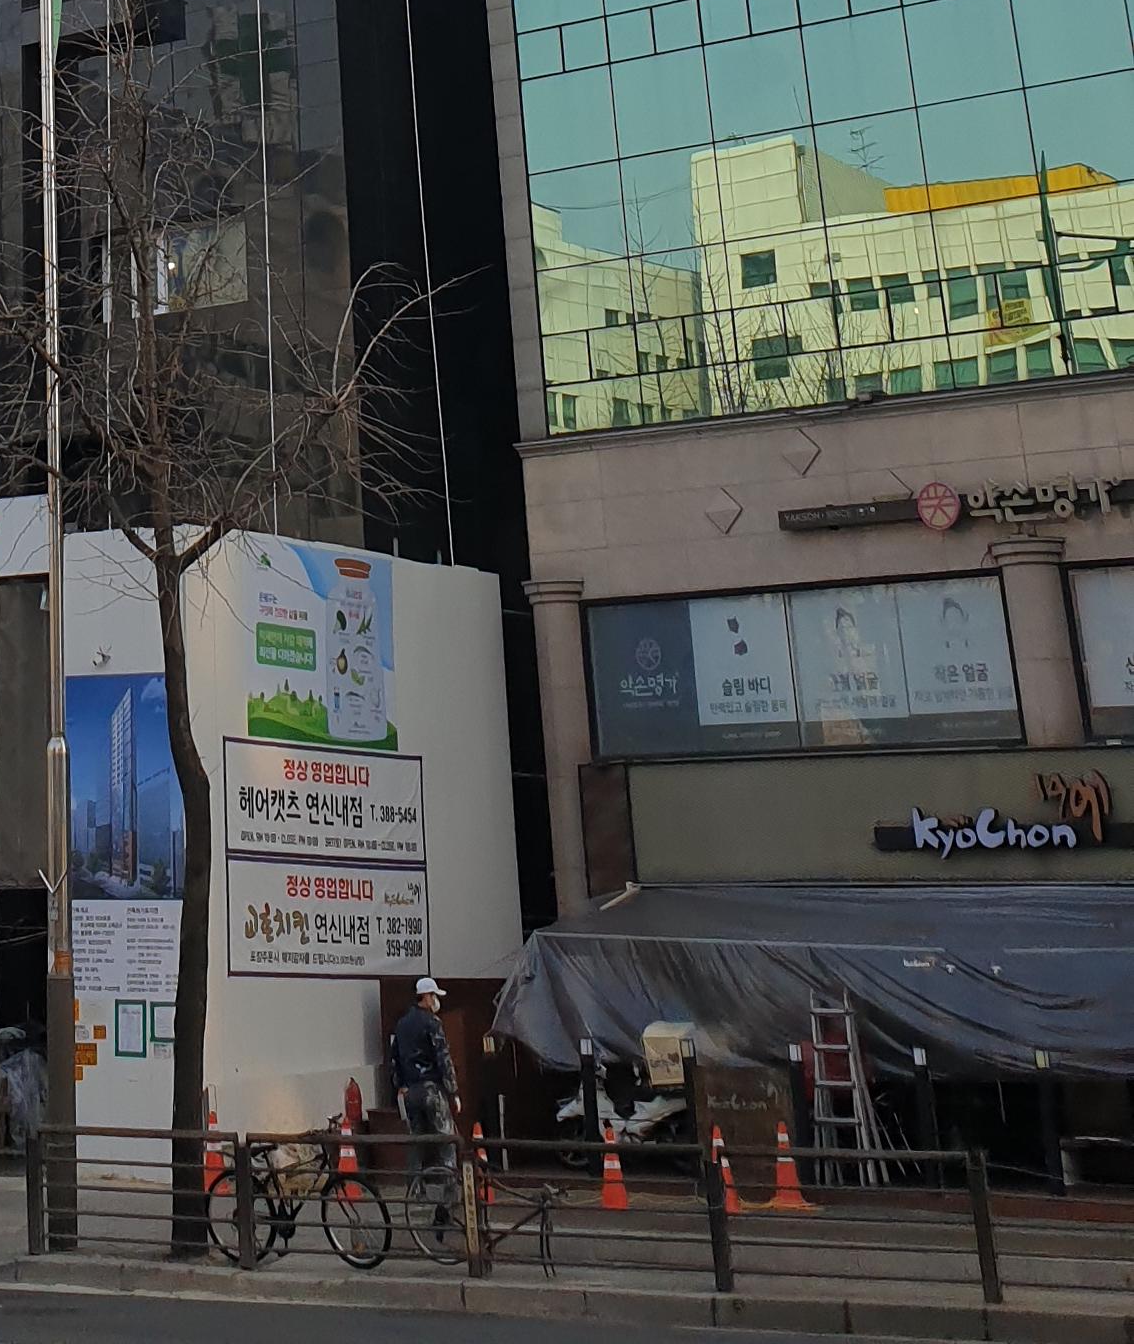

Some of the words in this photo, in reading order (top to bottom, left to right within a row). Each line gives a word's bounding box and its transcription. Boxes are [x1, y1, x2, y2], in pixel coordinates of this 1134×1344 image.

[968, 471, 1113, 524] 약손명가
[748, 675, 772, 695] 바디
[283, 758, 309, 782] 정상
[311, 761, 370, 788] 영업합니다
[238, 785, 302, 824] 헤어캣츠
[306, 791, 364, 829] 연신내점
[286, 874, 312, 899] 정상
[314, 876, 374, 902] 영업합니다
[314, 912, 371, 946] 연신내점
